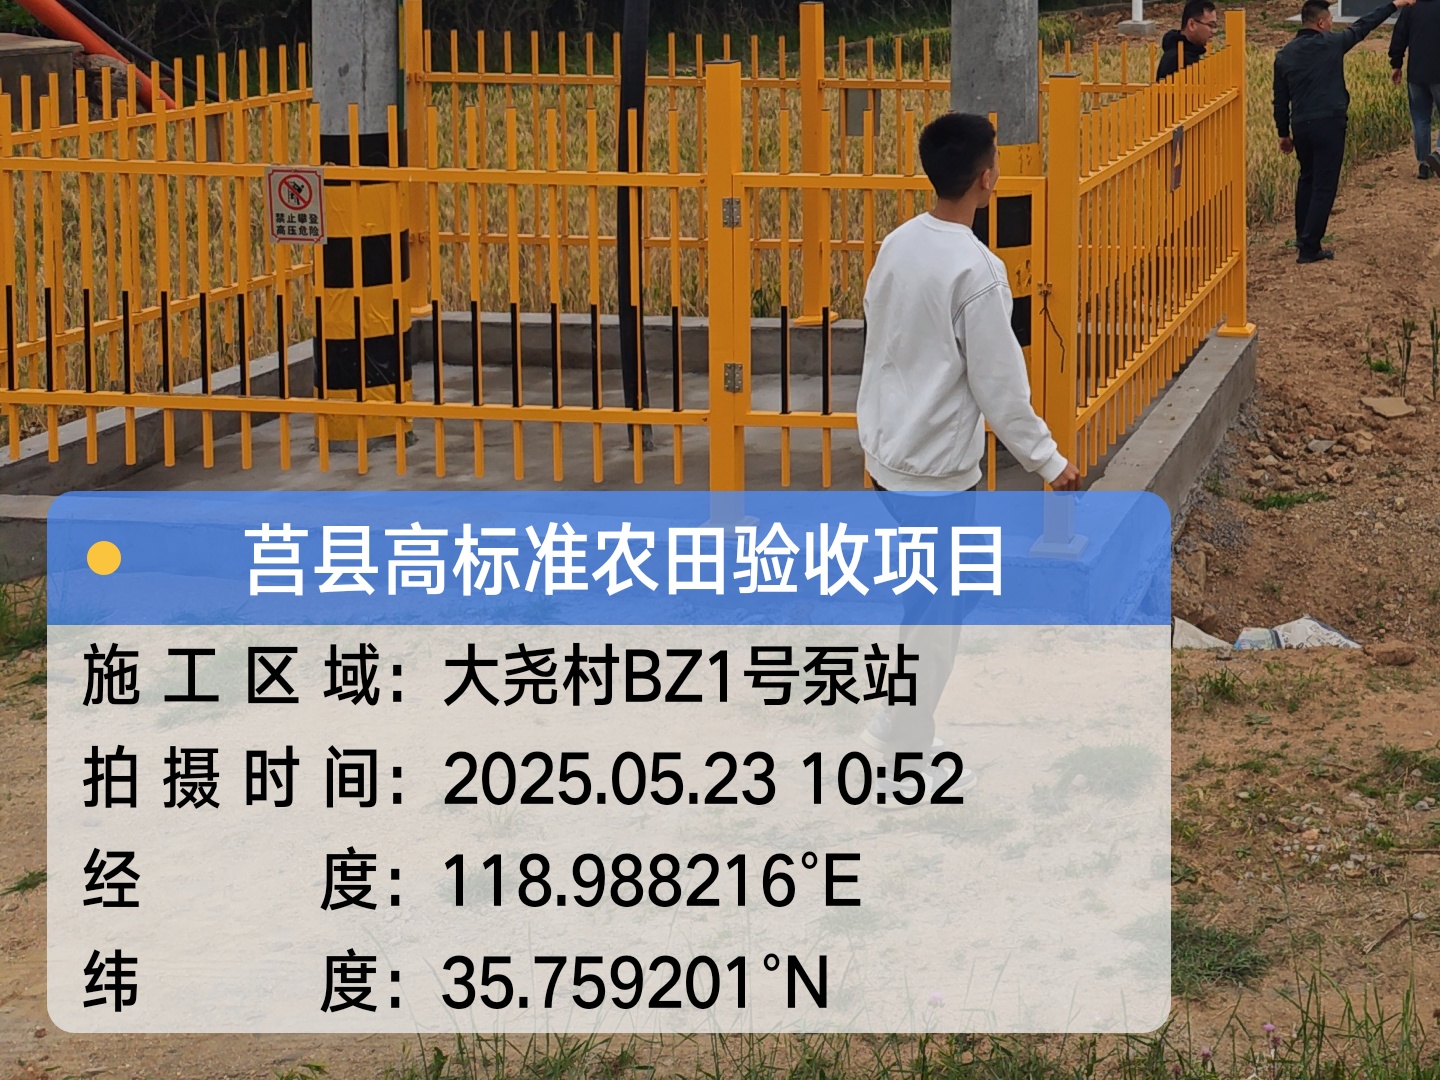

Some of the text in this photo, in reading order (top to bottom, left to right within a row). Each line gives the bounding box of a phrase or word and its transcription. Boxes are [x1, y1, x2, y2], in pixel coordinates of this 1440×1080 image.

[275, 212, 319, 225] 禁止攀登
[276, 225, 319, 237] 高压危险
